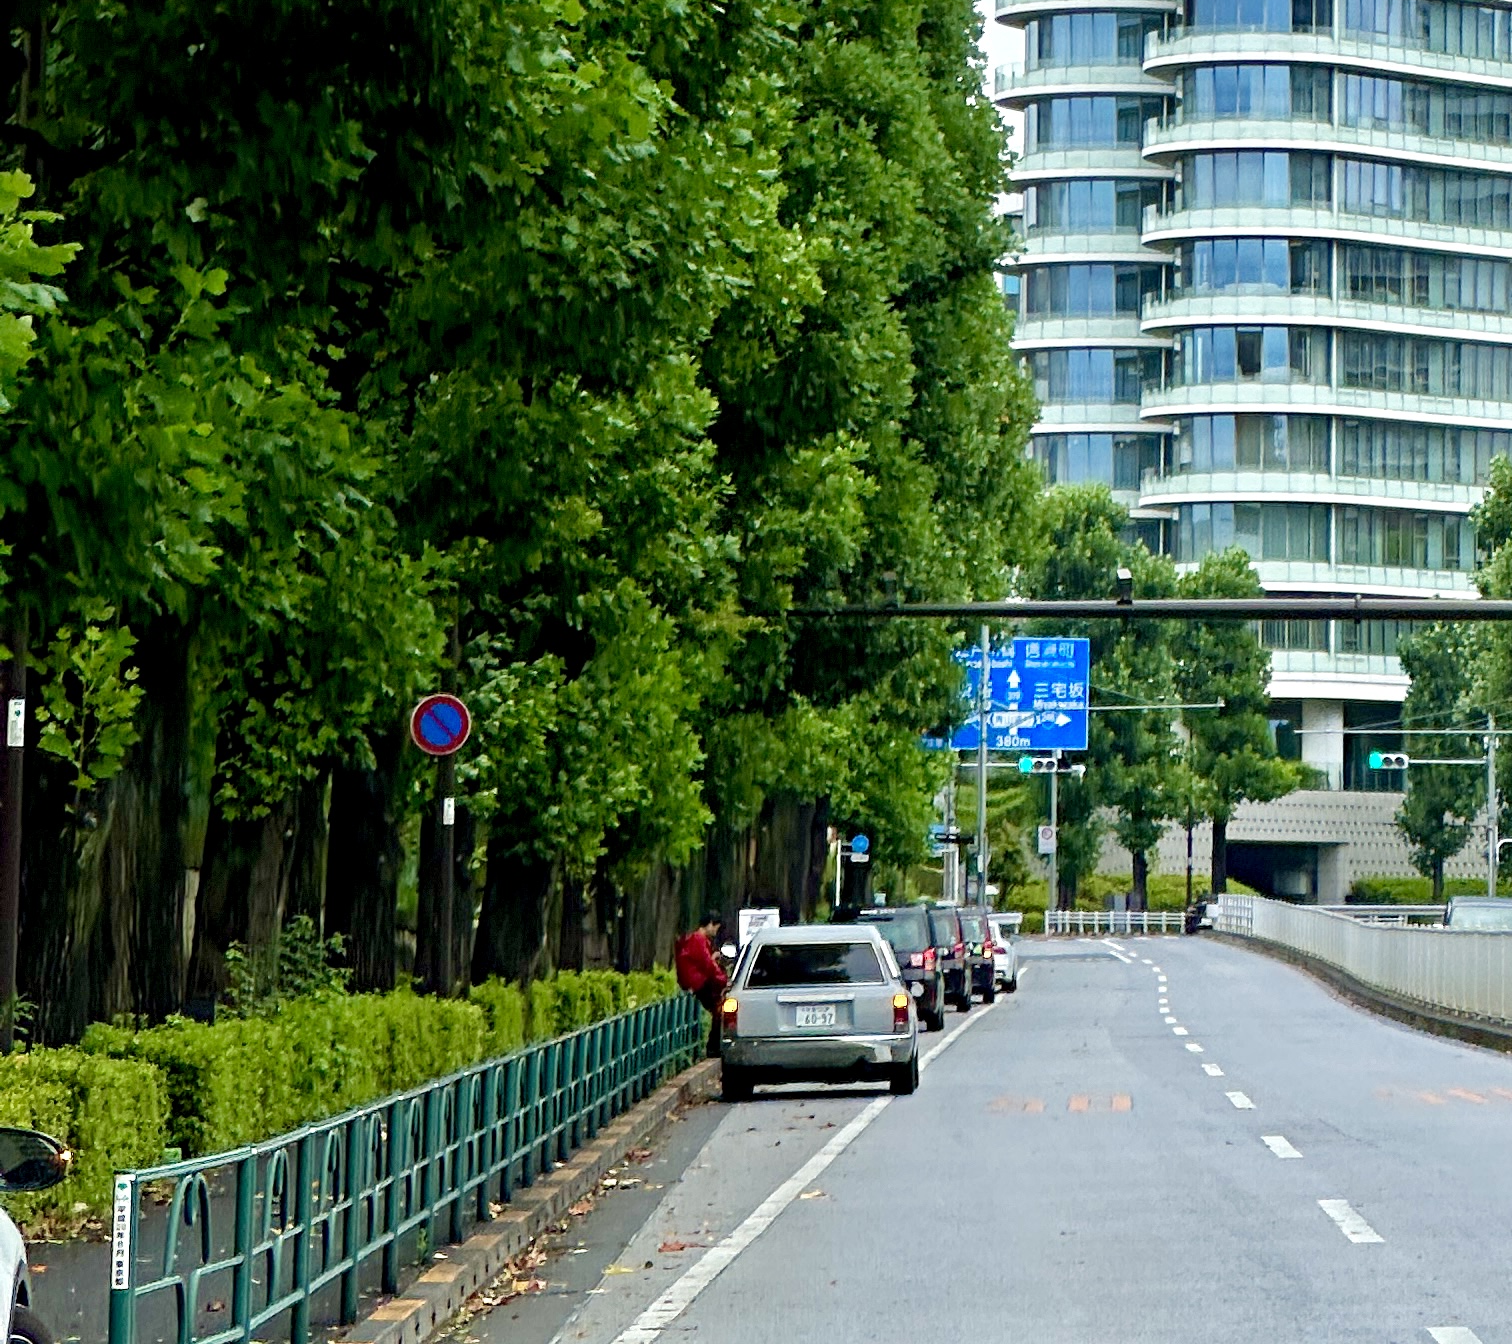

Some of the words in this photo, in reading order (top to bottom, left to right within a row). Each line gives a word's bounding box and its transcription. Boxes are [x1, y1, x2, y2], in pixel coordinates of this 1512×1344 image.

[1034, 682, 1084, 699] 三宅坂
[996, 735, 1031, 747] 380m
